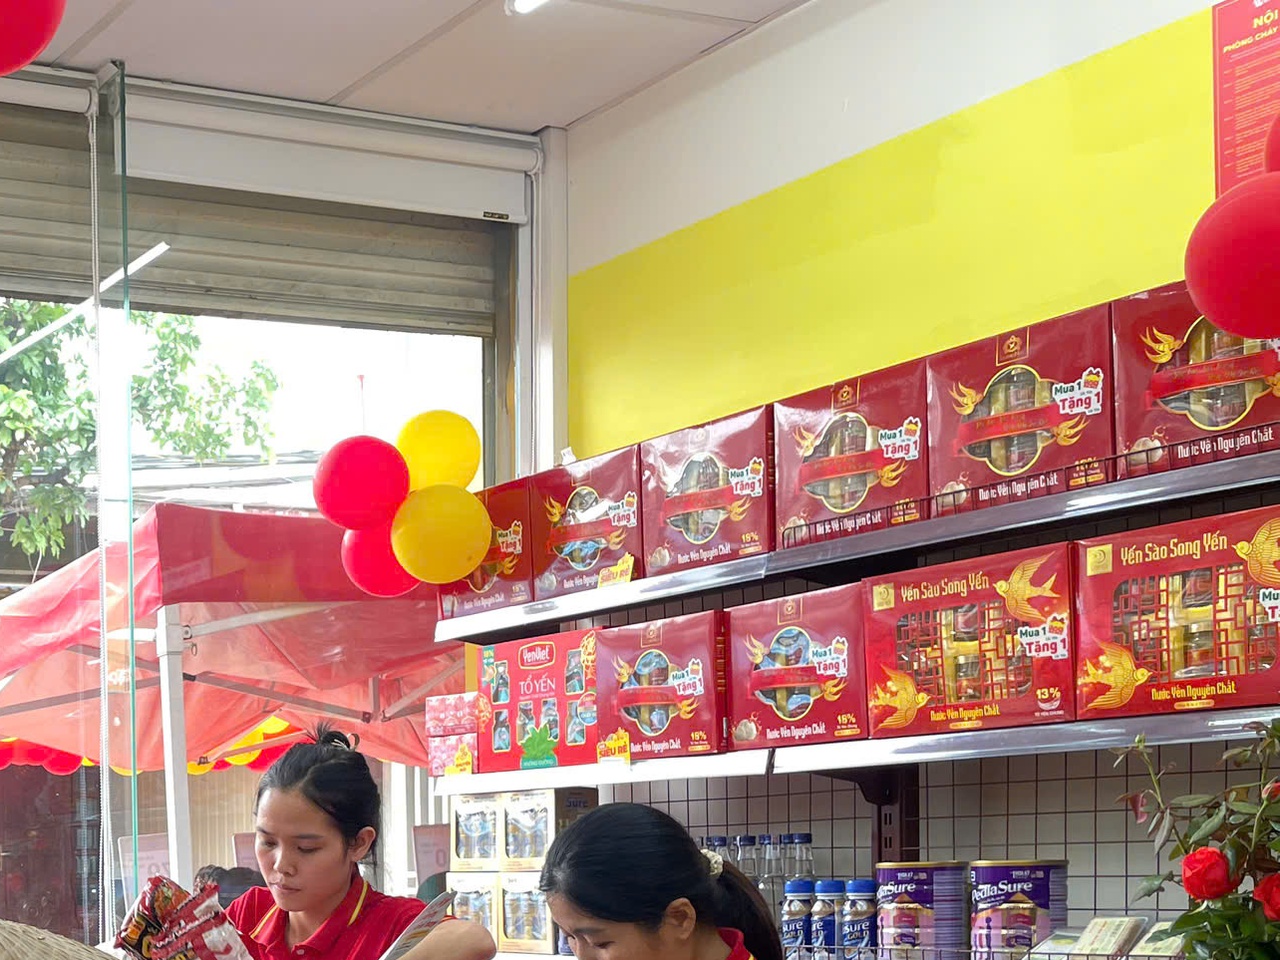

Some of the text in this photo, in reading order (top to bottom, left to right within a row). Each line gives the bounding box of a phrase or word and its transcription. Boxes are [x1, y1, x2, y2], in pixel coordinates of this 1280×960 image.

[1054, 381, 1081, 395] Mua 1
[1060, 392, 1101, 413] Tặng 1
[880, 429, 902, 441] Mua 1
[884, 439, 918, 457] Tặng 1
[1120, 530, 1228, 566] Yến Sào Song Yến
[901, 571, 989, 602] Yến Sào Song Yến
[1262, 590, 1280, 602] Mu
[1020, 627, 1046, 638] Mua 1
[1026, 638, 1067, 657] Tặng 1
[519, 673, 556, 695] TỔ YẾN
[1036, 687, 1061, 699] 13%
[843, 920, 870, 932] sure
